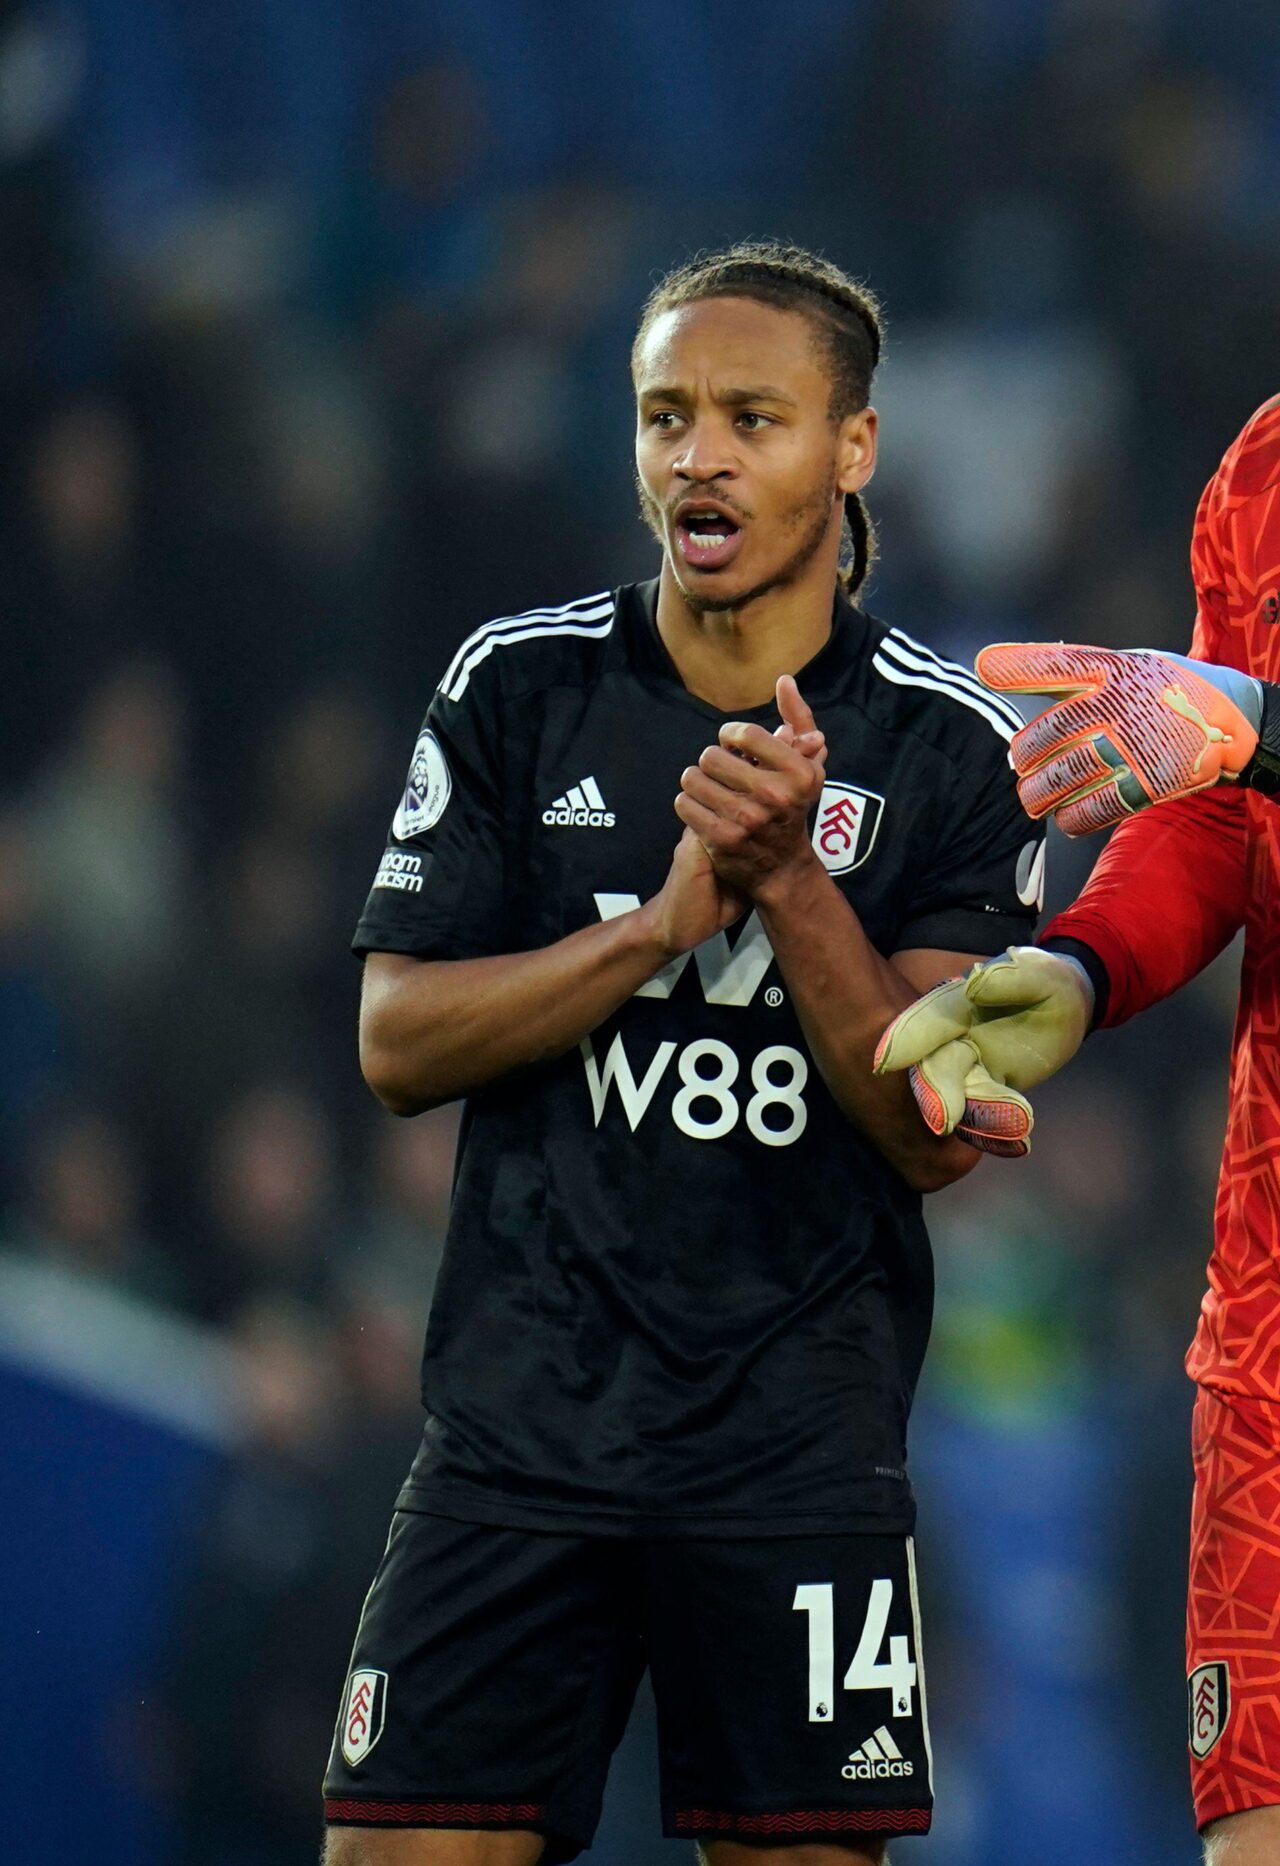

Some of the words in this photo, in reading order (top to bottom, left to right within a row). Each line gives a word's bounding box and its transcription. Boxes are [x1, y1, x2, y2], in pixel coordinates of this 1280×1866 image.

[542, 807, 616, 828] adidas
[819, 798, 860, 856] FFC
[579, 1030, 808, 1147] W88
[792, 1578, 916, 1723] 14
[348, 1681, 371, 1746] FFC
[1195, 1676, 1216, 1740] FFC
[841, 1758, 914, 1780] adidas
